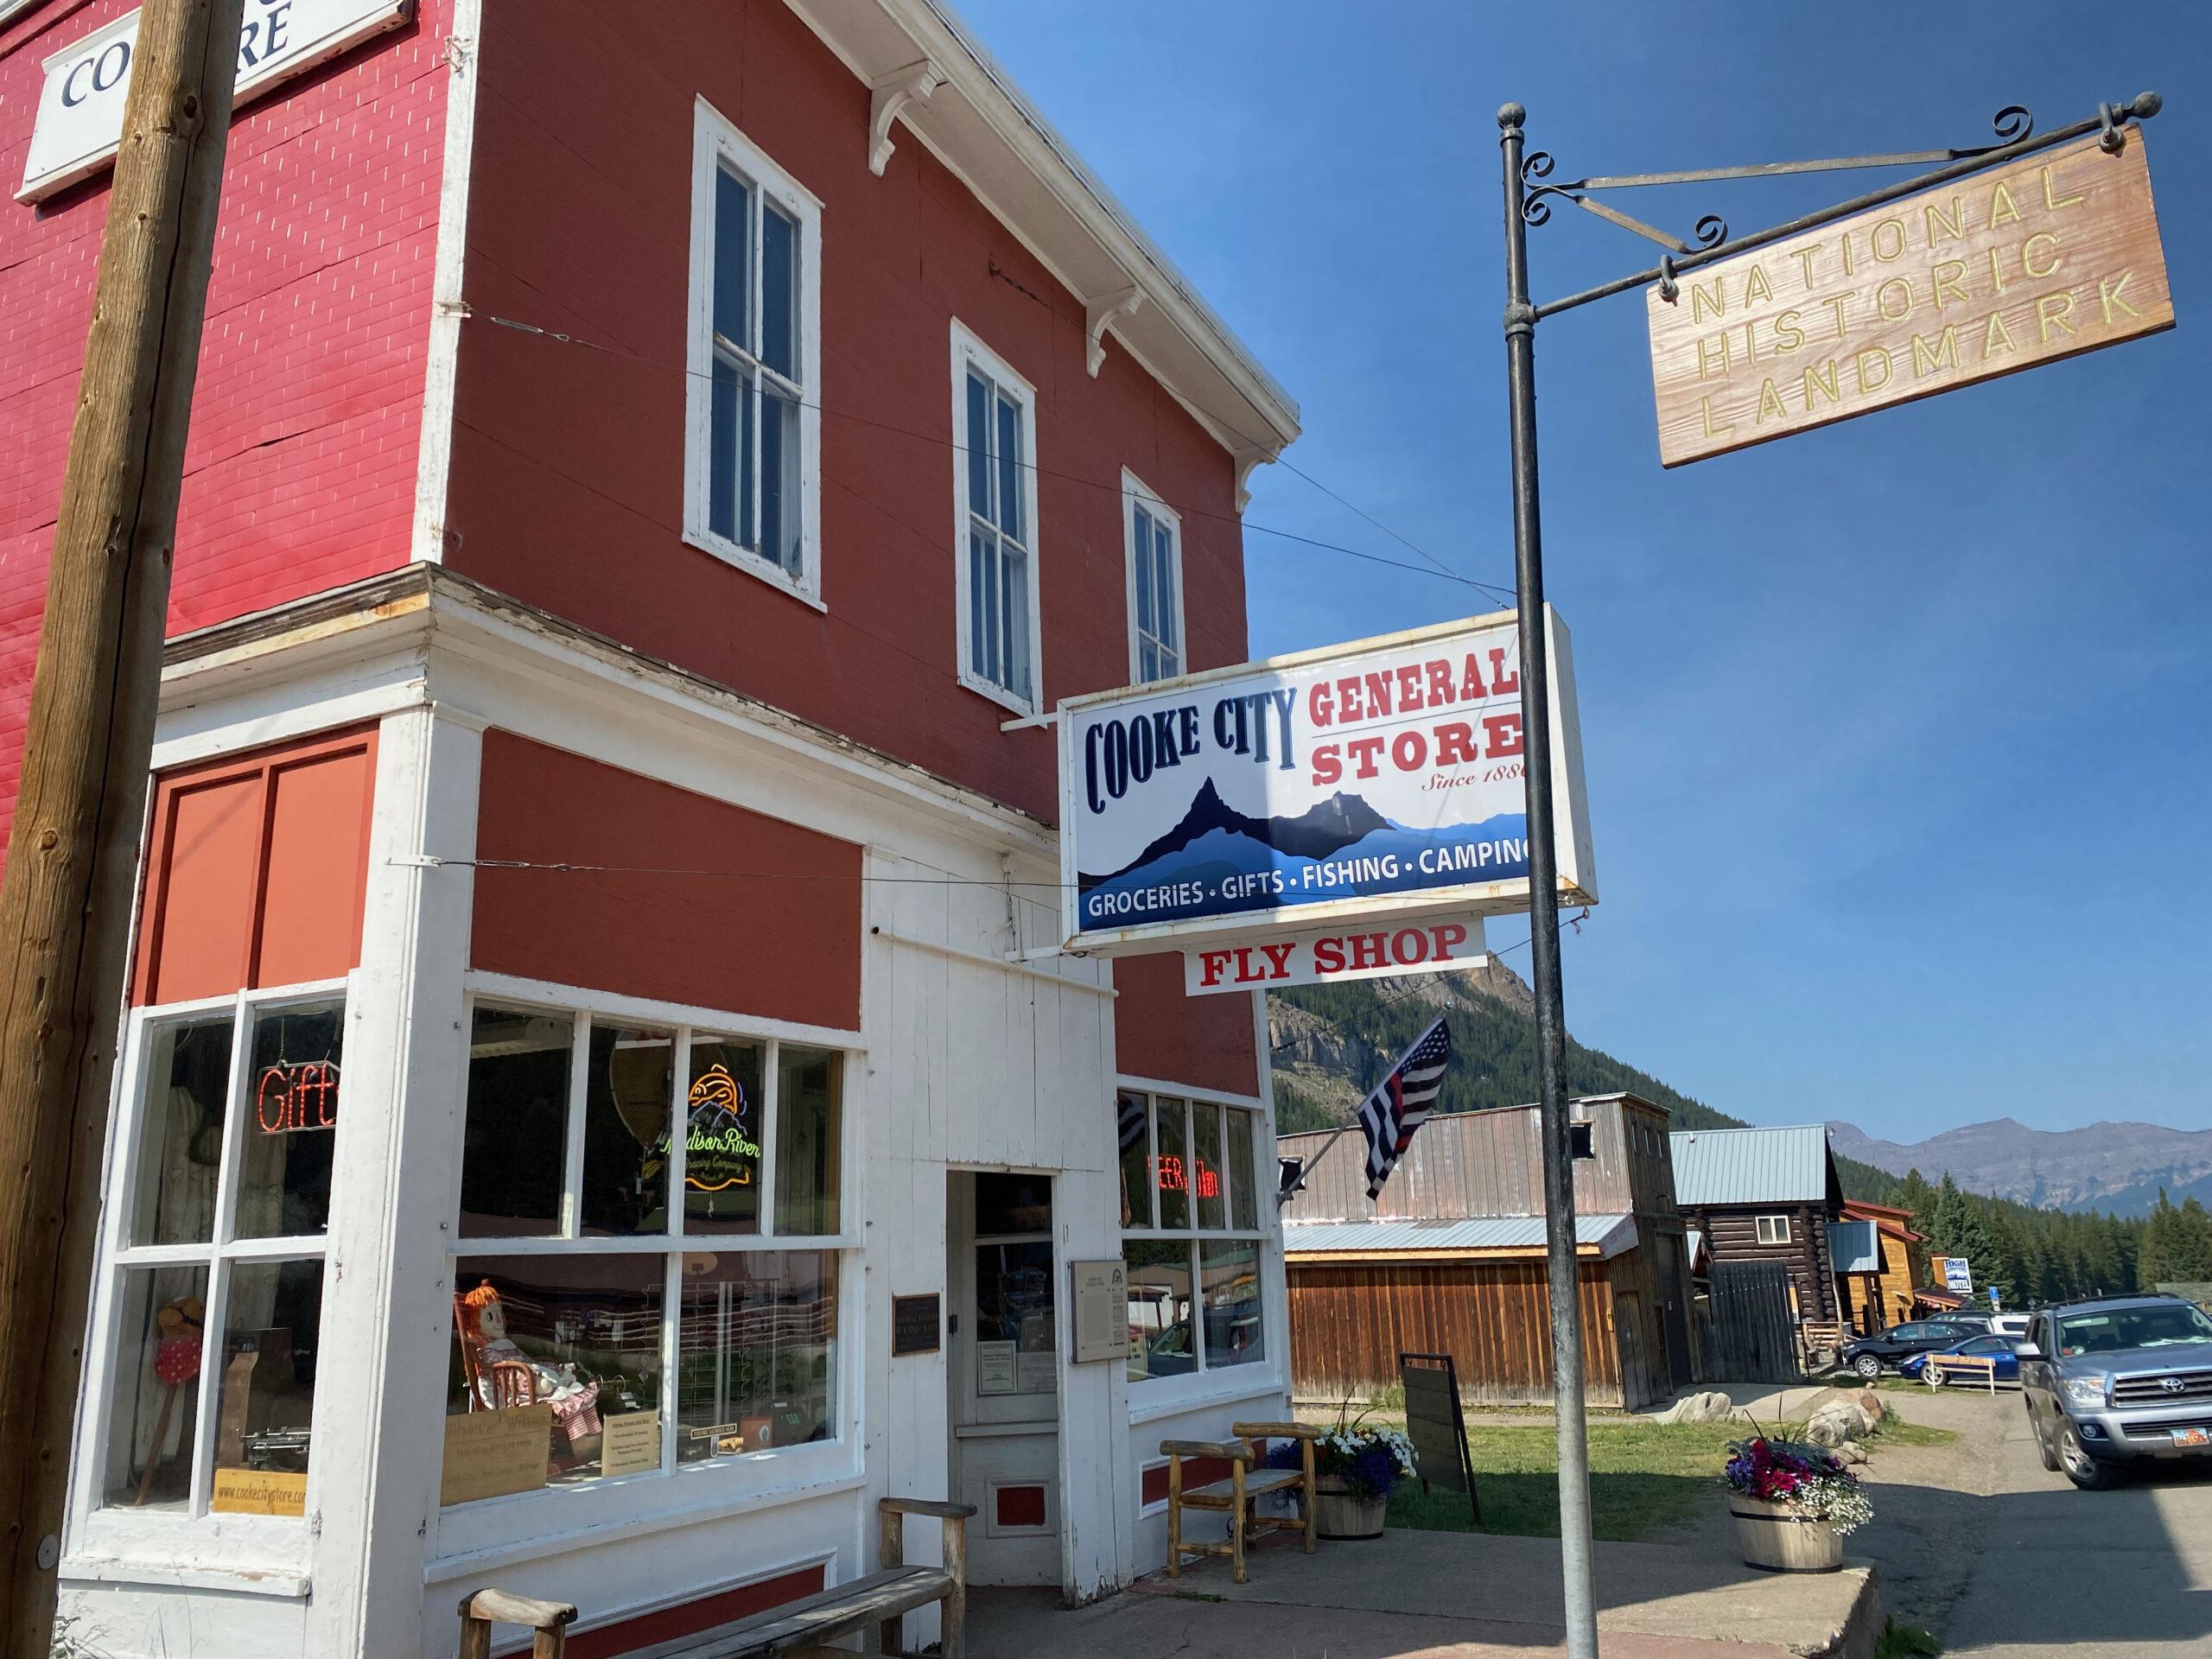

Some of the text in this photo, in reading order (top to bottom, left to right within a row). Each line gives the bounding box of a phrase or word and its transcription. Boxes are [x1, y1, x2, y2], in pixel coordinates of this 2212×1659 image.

[235, 1, 291, 74] RE
[61, 41, 132, 107] CO
[1691, 167, 2084, 325] NATIONAL
[1696, 231, 2064, 380] HISTORIC
[1702, 271, 2140, 438] LANDMARK
[1309, 648, 1520, 728] GENERAL
[1085, 687, 1297, 814] COOKE CITY
[1312, 713, 1523, 786] STORE
[1421, 773, 1477, 791] Since
[1089, 880, 1203, 917] GROCERIES
[1221, 869, 1284, 899] GIFTS
[1302, 854, 1399, 889] FISHING
[1199, 924, 1466, 987] FLY SHOP
[258, 1064, 340, 1133] Gift
[660, 1125, 760, 1158] dison River
[1147, 1154, 1183, 1188] EER
[1948, 1279, 1970, 1289] MOTEL
